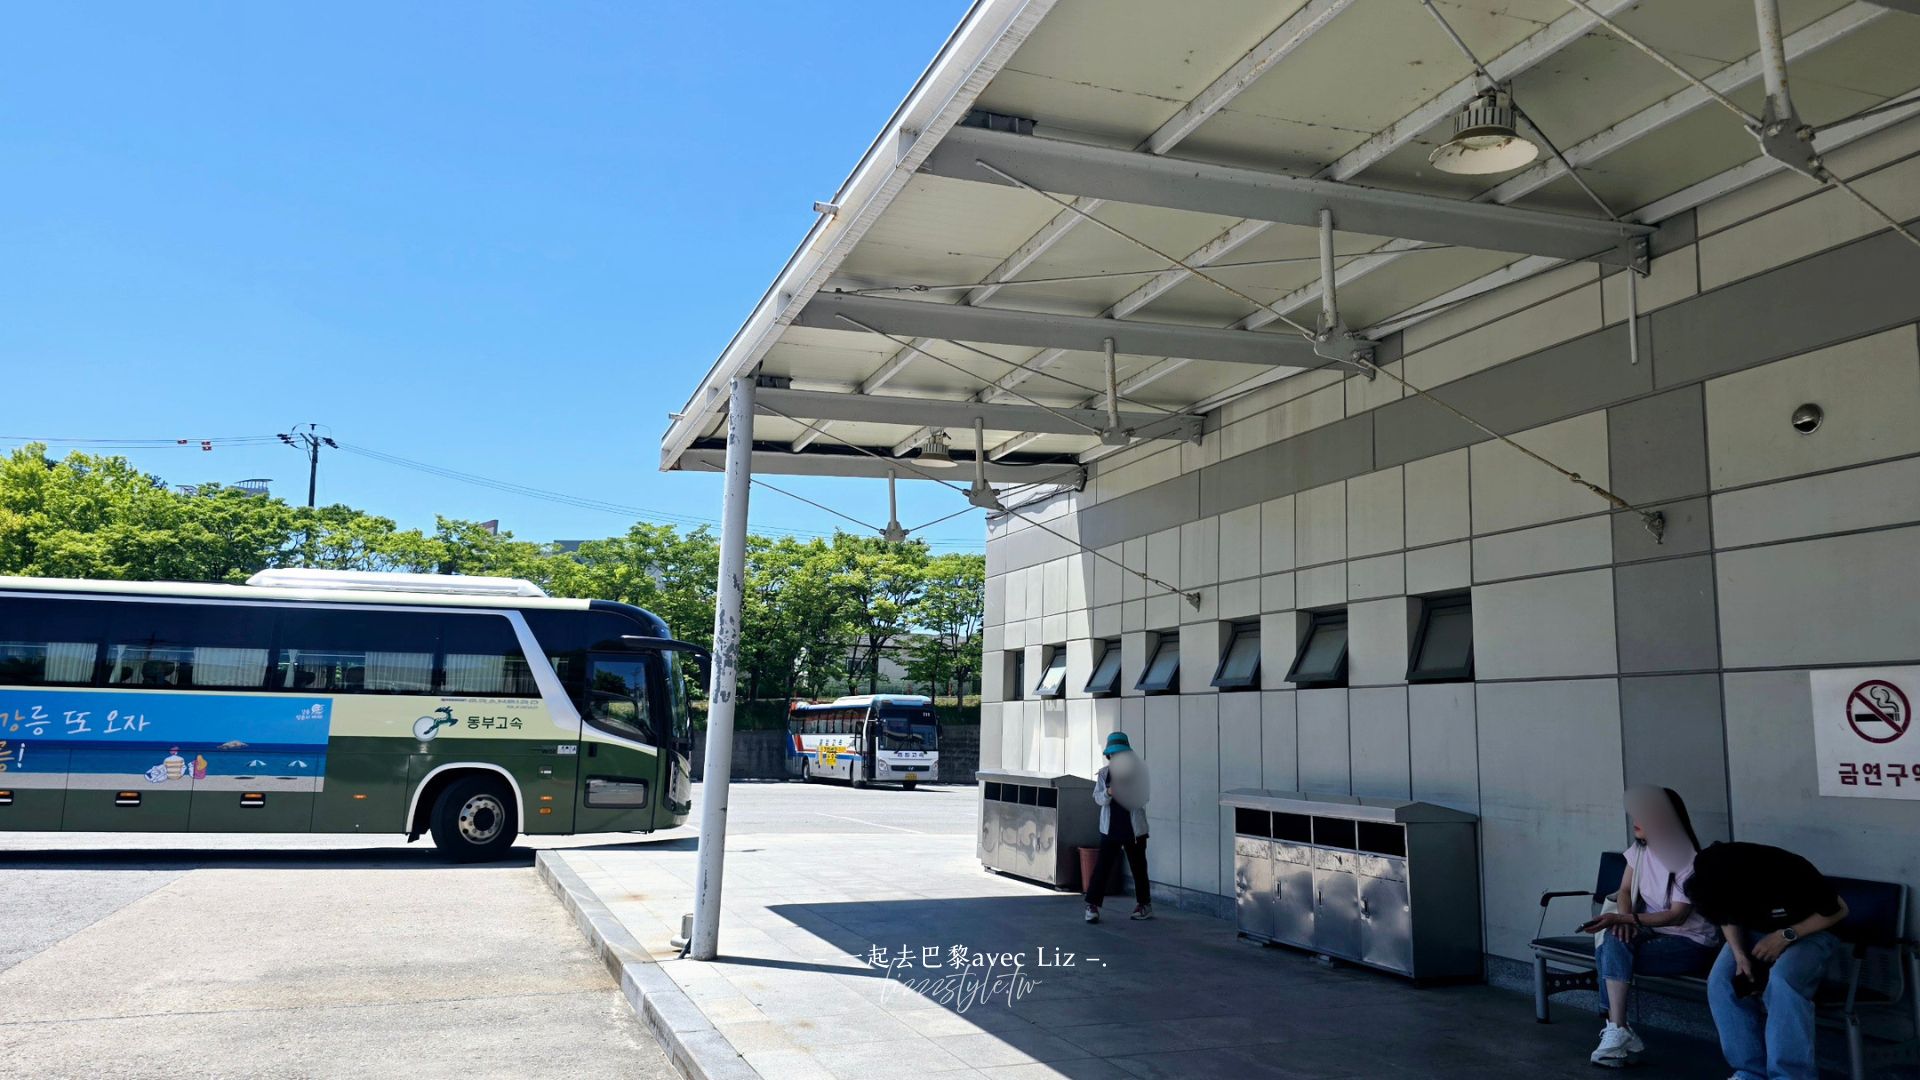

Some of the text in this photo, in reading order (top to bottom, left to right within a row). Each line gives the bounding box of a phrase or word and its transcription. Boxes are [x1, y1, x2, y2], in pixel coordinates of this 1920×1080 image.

[63, 710, 92, 735] 또
[103, 709, 151, 733] 오자
[467, 716, 523, 730] 동부고속
